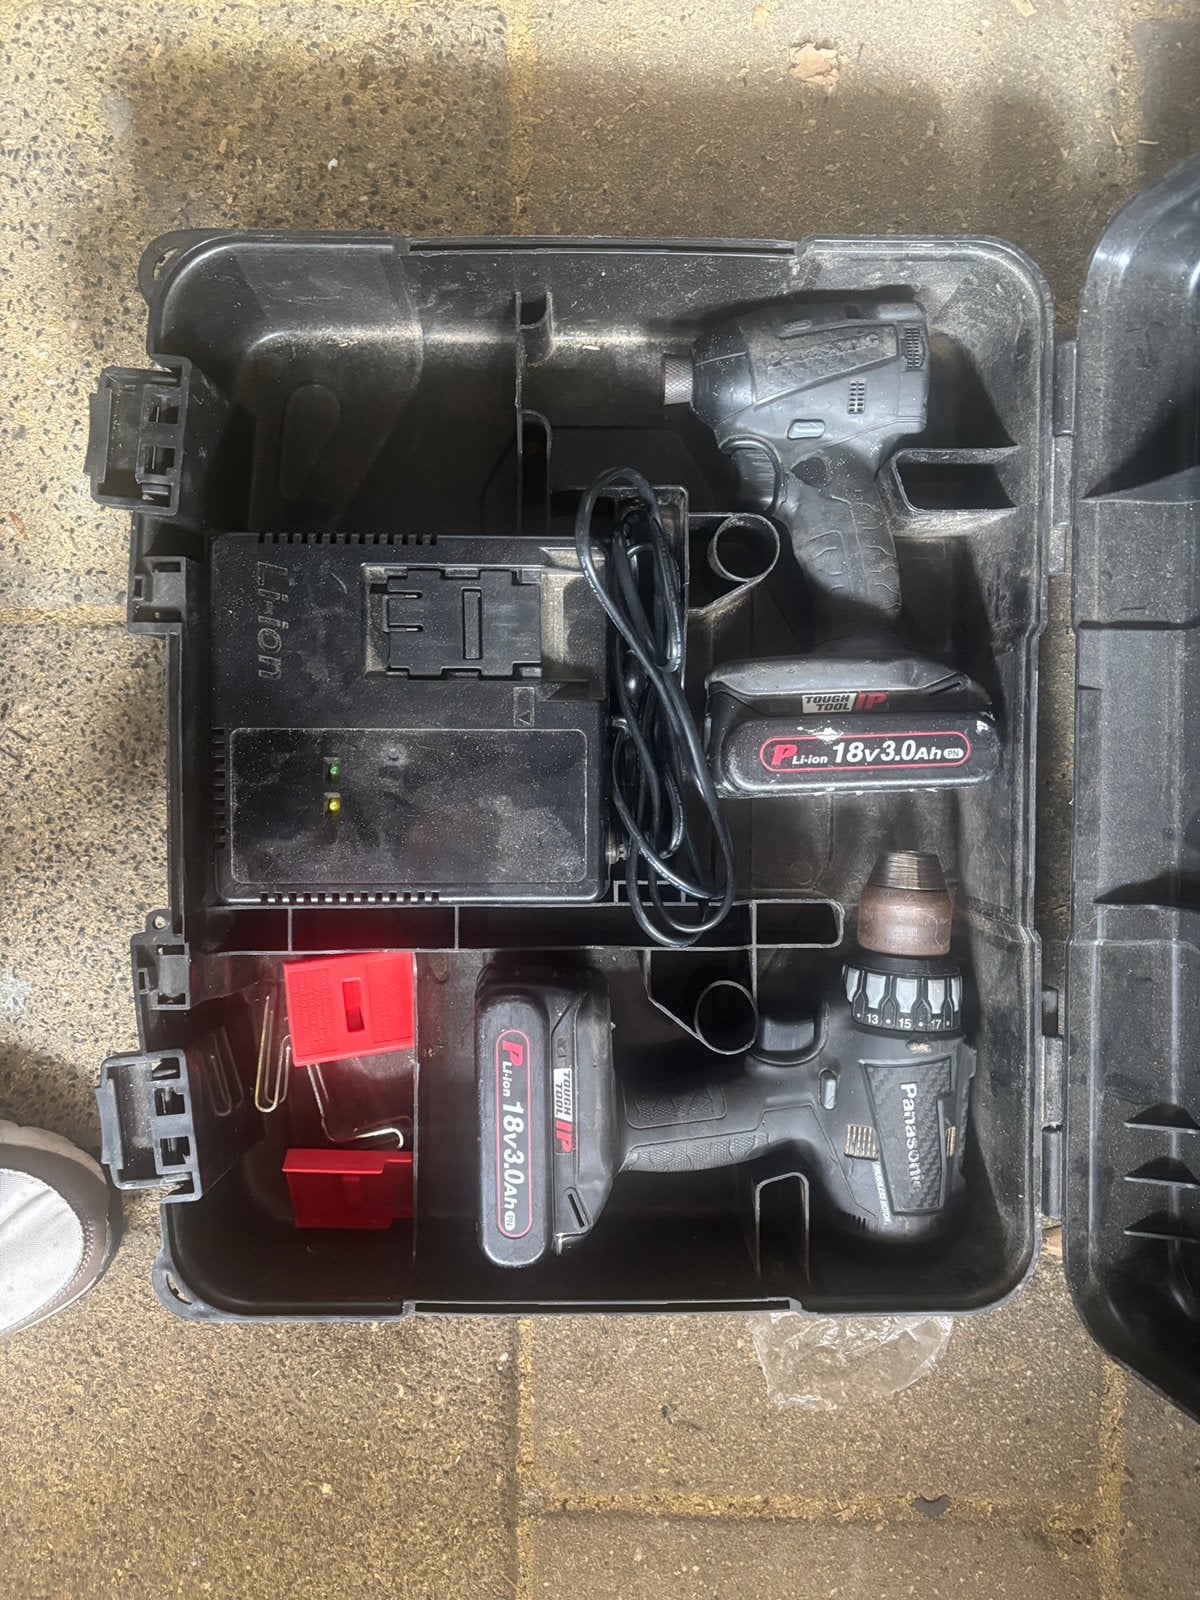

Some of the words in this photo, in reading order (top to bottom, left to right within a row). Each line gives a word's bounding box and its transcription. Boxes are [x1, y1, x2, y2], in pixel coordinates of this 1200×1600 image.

[257, 561, 290, 679] Li-ion
[805, 694, 850, 703] TOUGH
[816, 703, 851, 712] TOOL
[855, 693, 888, 710] IP
[792, 754, 828, 765] Li-ion
[866, 1013, 879, 1025] 13
[898, 1018, 912, 1029] 15
[930, 1019, 942, 1029] 17
[502, 1061, 512, 1097] Li-ion
[555, 1081, 563, 1116] TOOL
[562, 1070, 572, 1116] TOUGH
[555, 1120, 573, 1154] IP
[900, 1083, 925, 1193] Panasonic
[873, 1164, 887, 1200] BRUSHLESS
[879, 1200, 891, 1223] MOTOR
